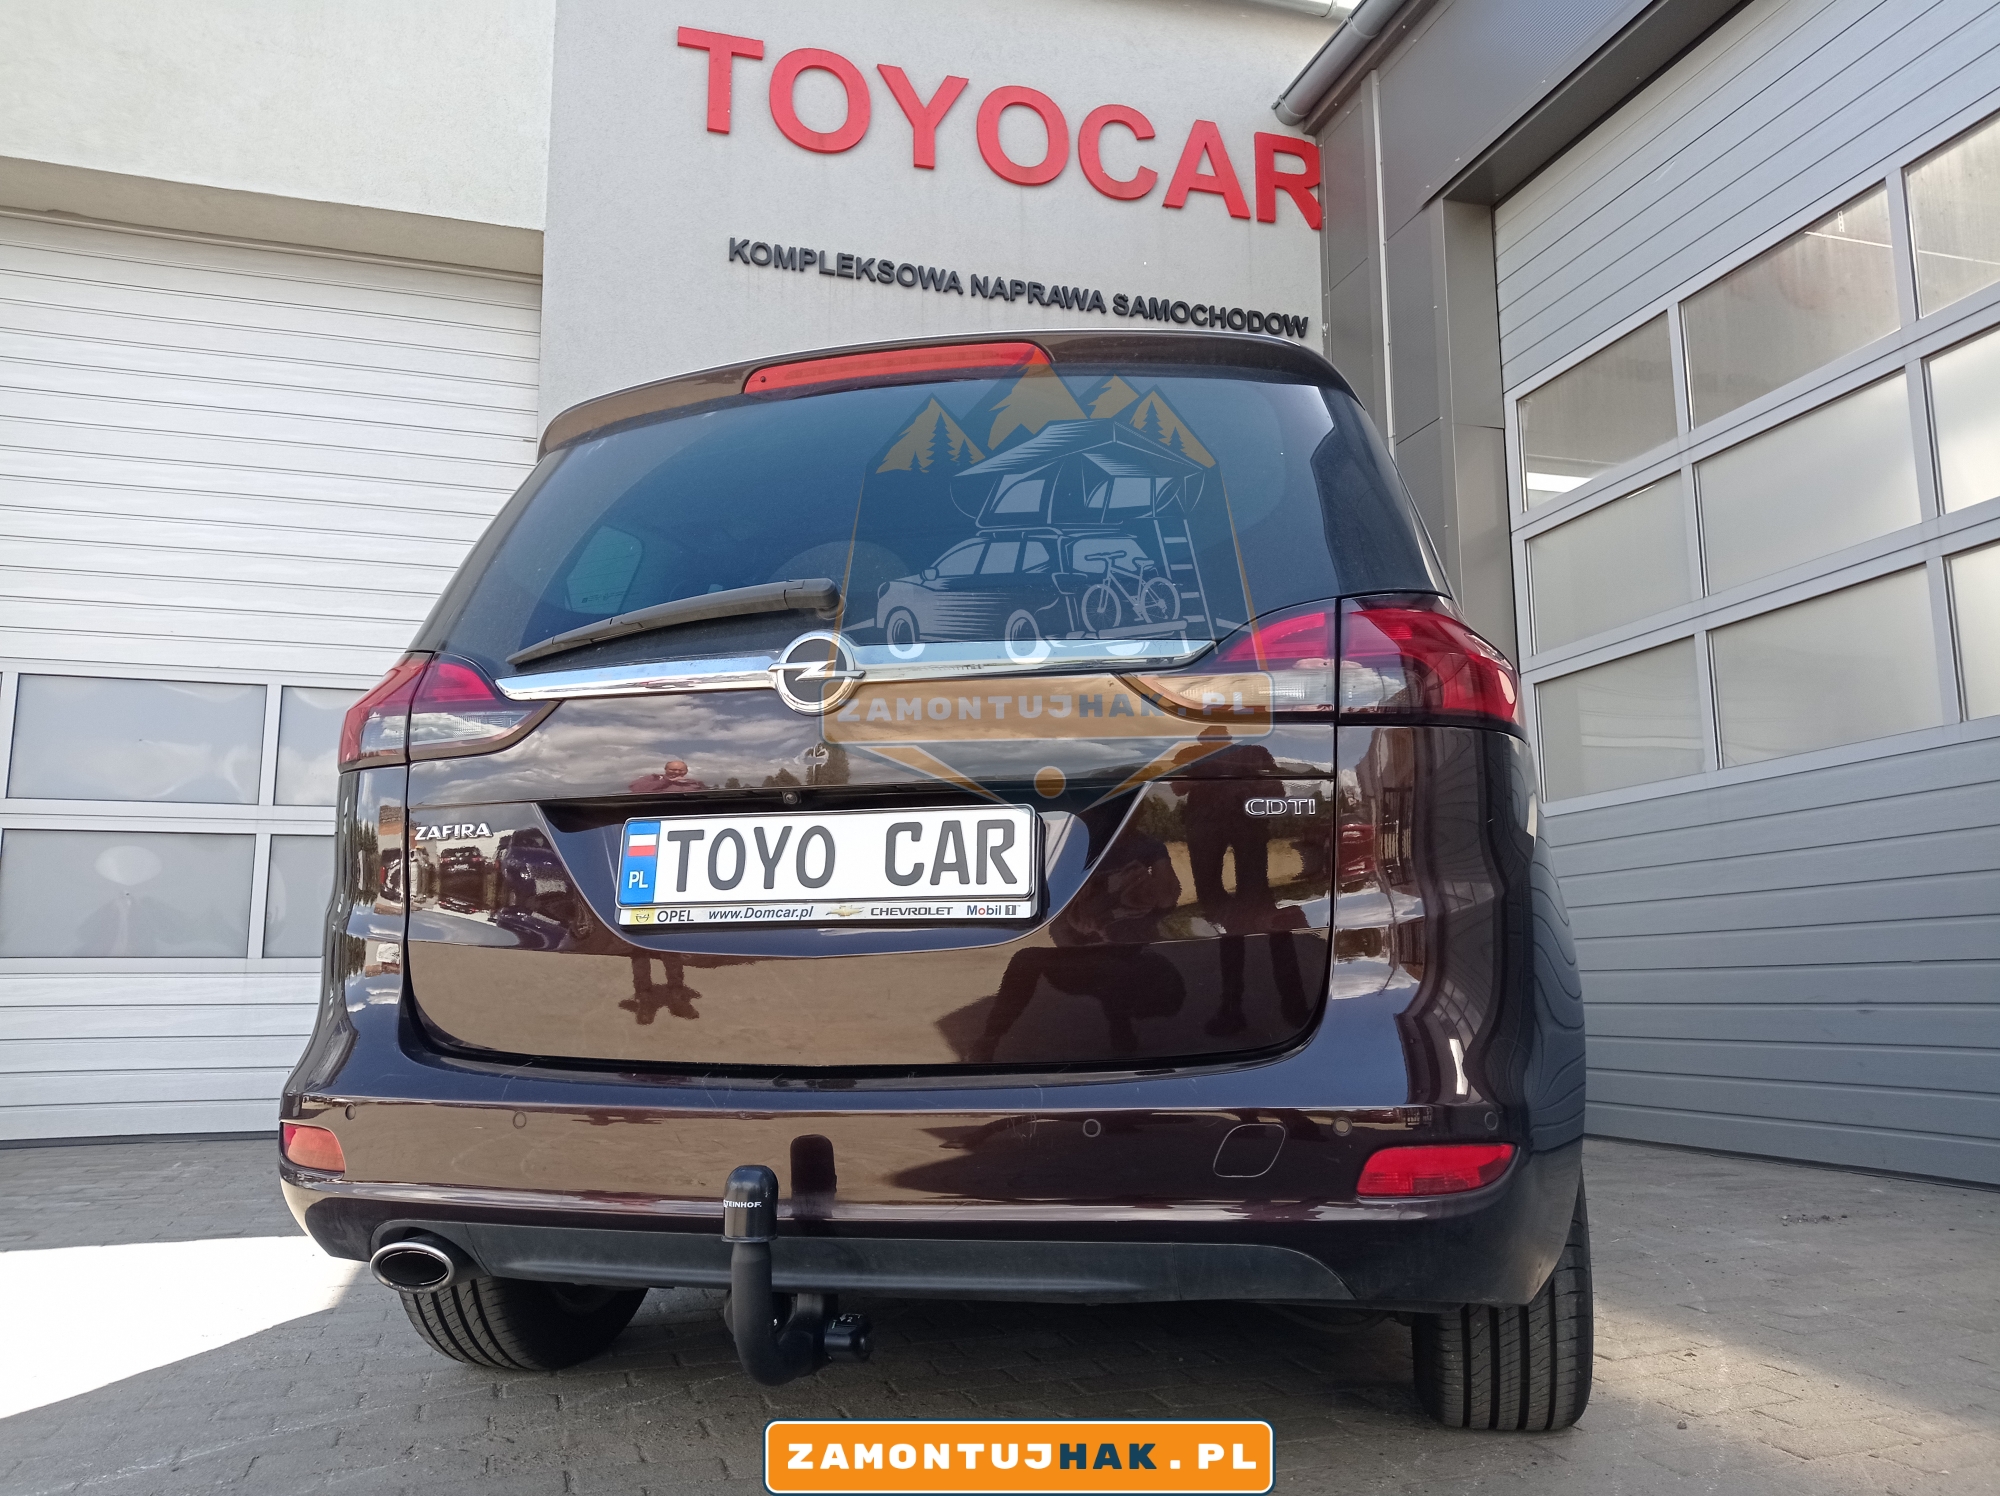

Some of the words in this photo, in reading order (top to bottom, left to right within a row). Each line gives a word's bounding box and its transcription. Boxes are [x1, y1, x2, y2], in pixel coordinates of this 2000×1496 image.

[678, 26, 1322, 230] TOYOCAR
[729, 237, 963, 295] KOMPLEKSOWA
[971, 274, 1106, 313] NAPRAWA
[1113, 293, 1308, 338] SAMOCHODOW
[1245, 799, 1316, 816] CDTI
[415, 823, 493, 841] ZAFIRA
[667, 825, 836, 893] TOYO
[885, 819, 1018, 887] CAR
[628, 870, 649, 889] PL
[657, 910, 694, 923] OPEL
[708, 906, 814, 921] www.Domcar.pl
[871, 906, 953, 916] CHEVROLET
[967, 905, 1001, 916] Mobil
